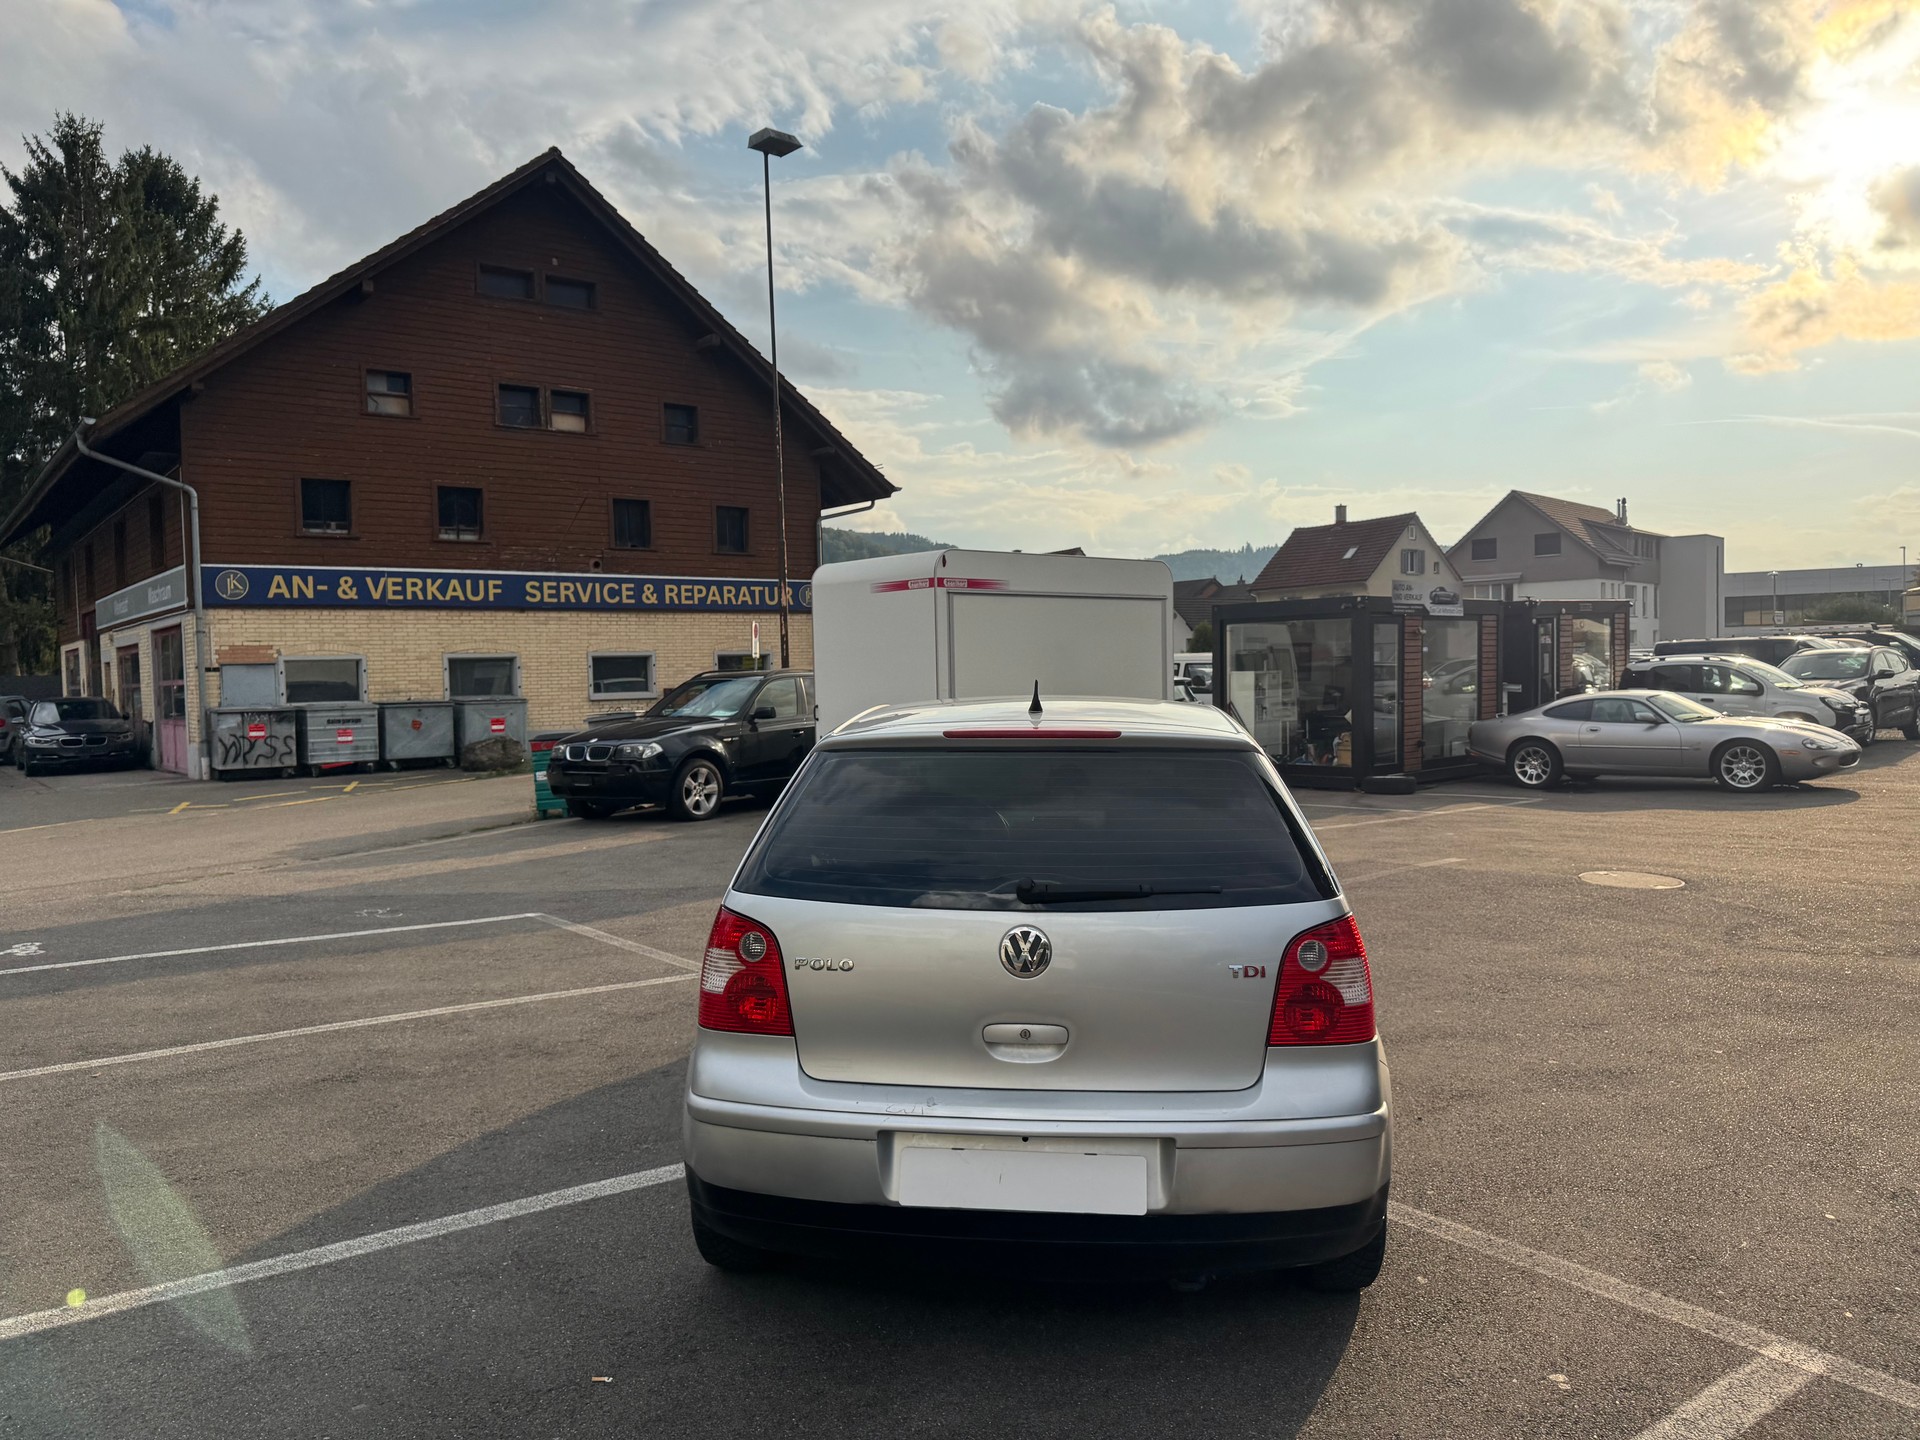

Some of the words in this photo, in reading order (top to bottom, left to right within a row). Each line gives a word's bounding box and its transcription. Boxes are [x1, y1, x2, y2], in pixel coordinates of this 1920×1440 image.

[267, 574, 329, 599] AN-
[337, 575, 358, 600] &
[365, 576, 503, 602] VERKAUF
[525, 580, 637, 604] SERVICE
[641, 583, 659, 605] &
[1001, 926, 1051, 977] VW
[794, 957, 855, 972] POLO
[1228, 964, 1266, 979] TDI
